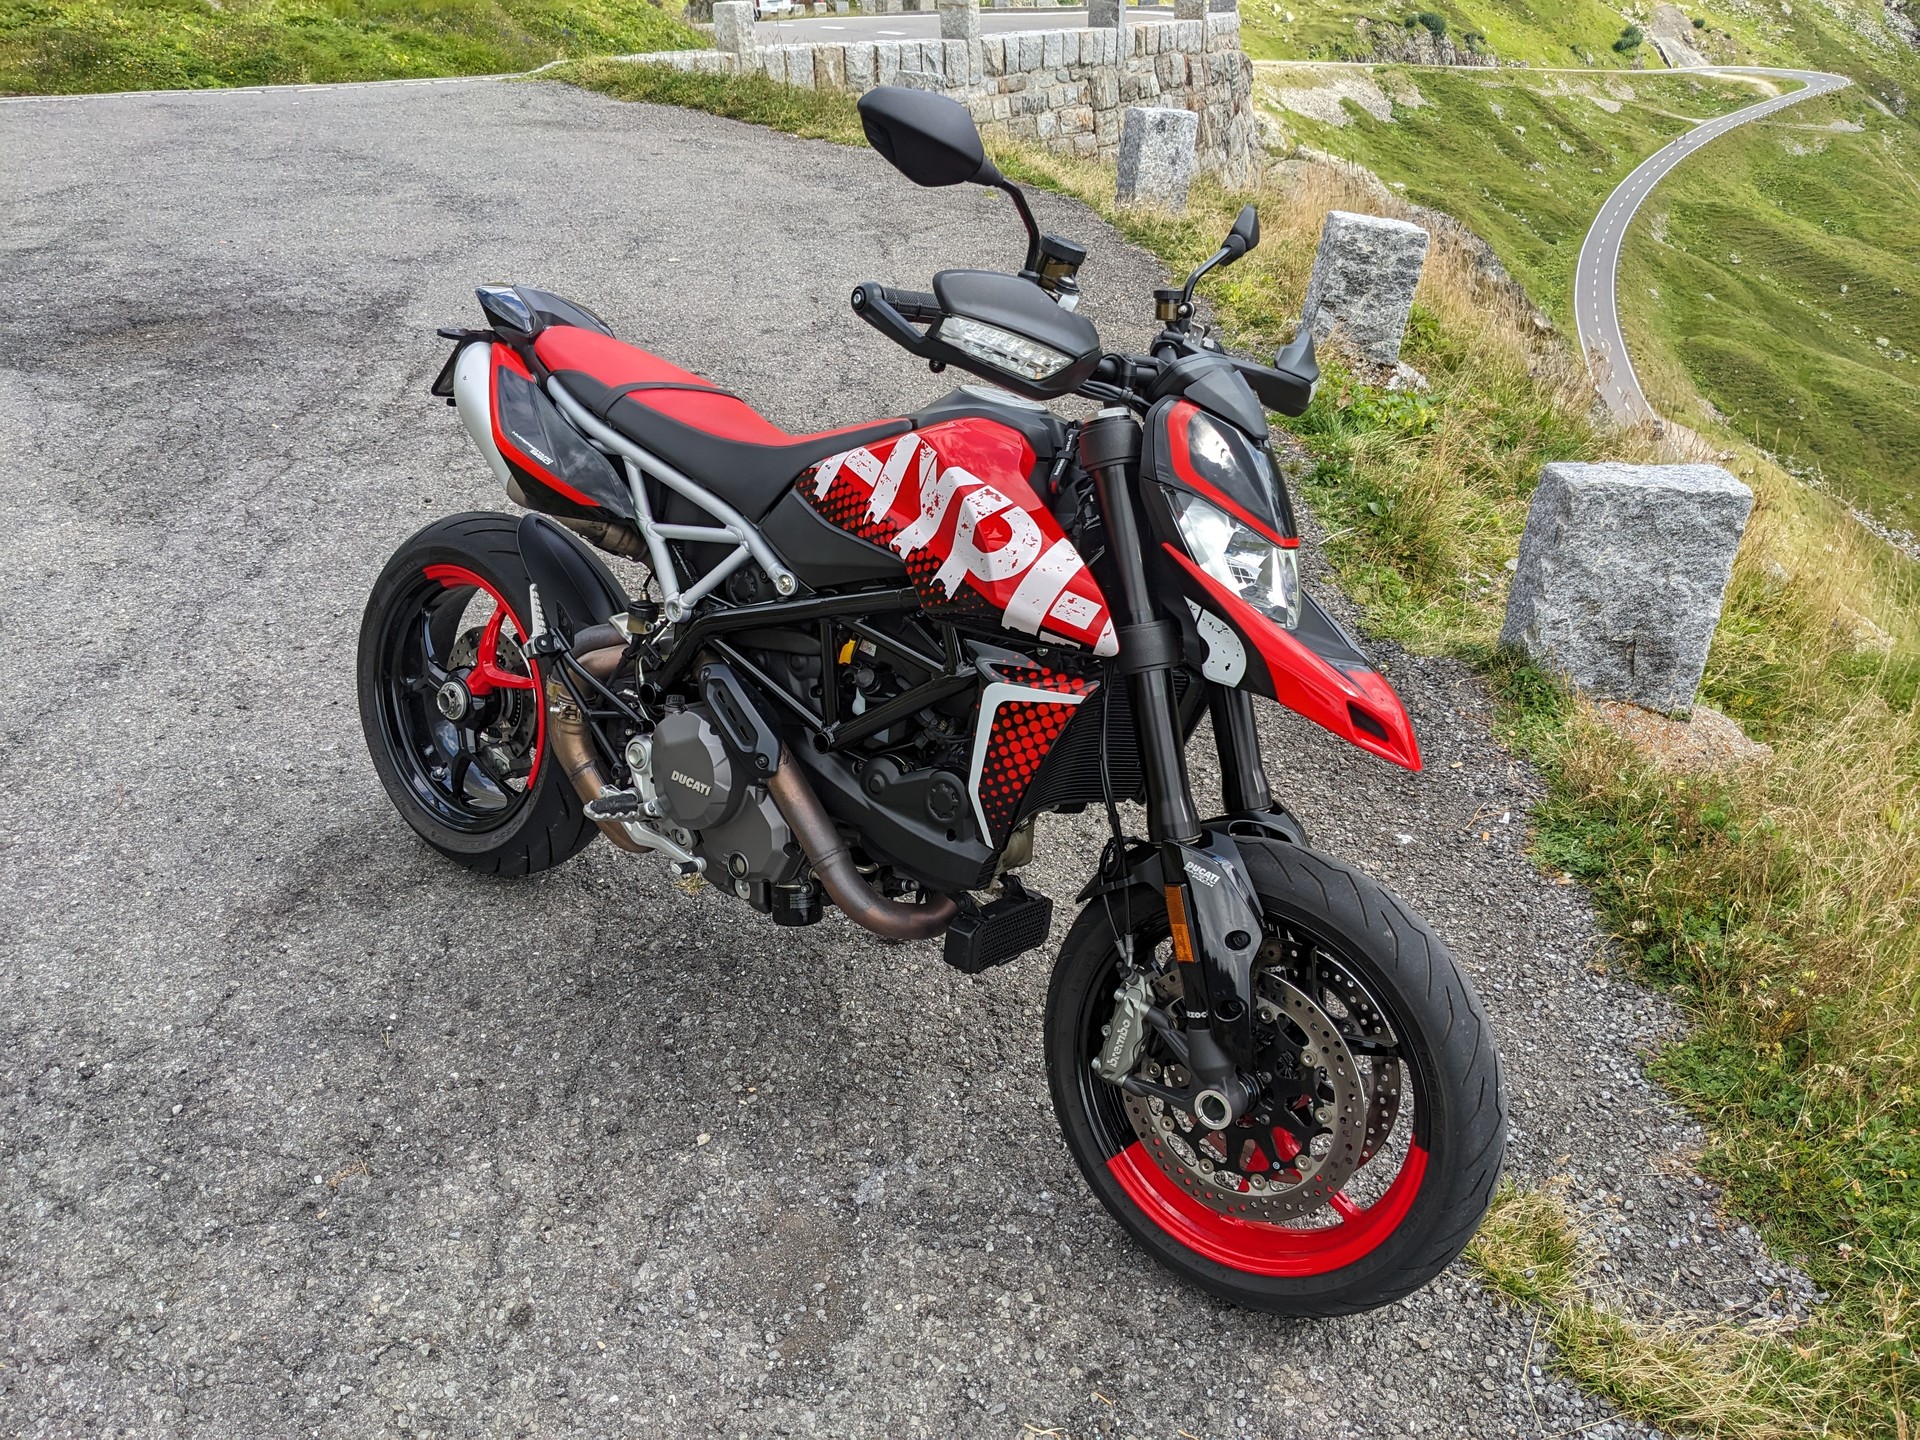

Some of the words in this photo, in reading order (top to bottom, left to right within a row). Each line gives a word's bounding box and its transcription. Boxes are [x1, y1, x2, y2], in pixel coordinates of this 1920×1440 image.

[670, 769, 712, 797] DUCATI
[1184, 861, 1221, 883] DUCATI
[1106, 1018, 1132, 1068] brembo
